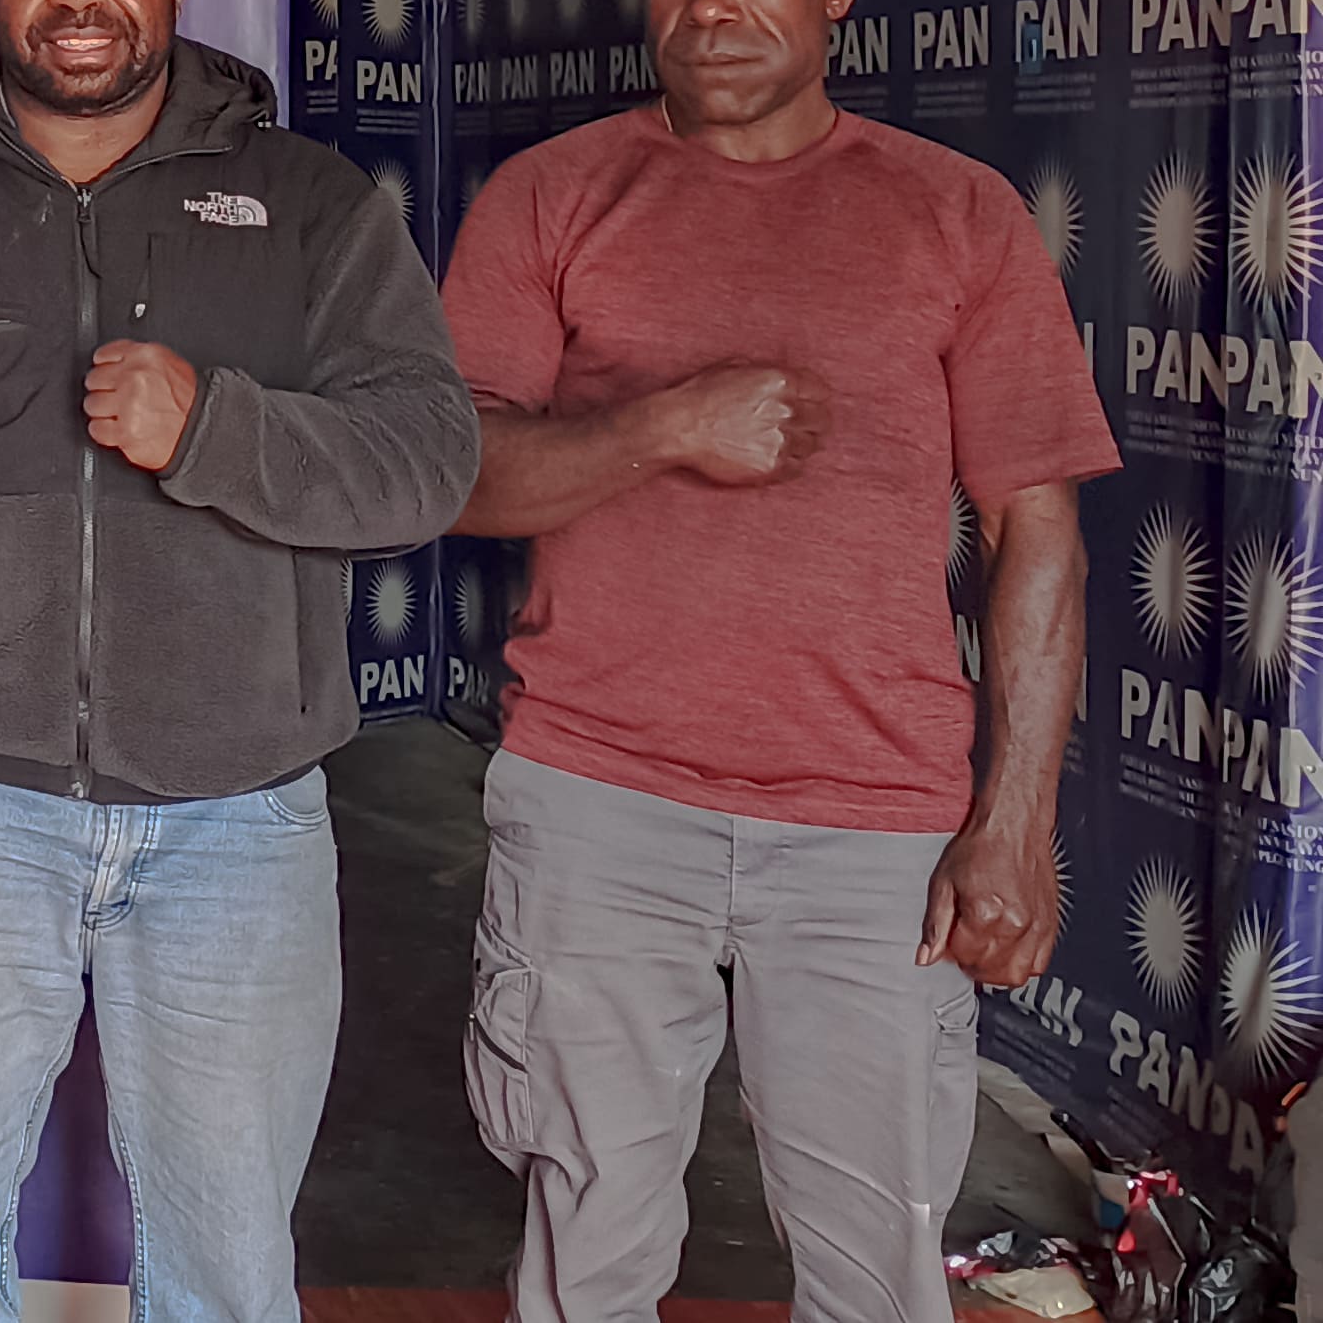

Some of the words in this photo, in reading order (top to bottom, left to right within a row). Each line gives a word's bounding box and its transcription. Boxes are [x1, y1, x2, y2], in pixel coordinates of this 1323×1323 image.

[827, 16, 889, 77] PAN
[914, 5, 989, 71] PAN
[356, 60, 422, 104] PAN
[456, 60, 491, 104] PAN
[501, 54, 537, 99] PAN
[550, 48, 595, 95] PAN
[609, 43, 659, 92] PAN
[184, 200, 237, 215] NORTH
[201, 213, 239, 224] FACE
[207, 192, 237, 205] THE
[1126, 326, 1227, 407] PAN
[360, 654, 425, 704] PAN
[1121, 668, 1219, 768] PAN
[1223, 708, 1323, 808] PAN
[983, 976, 1082, 1048] AN
[1110, 1010, 1214, 1131] PAN
